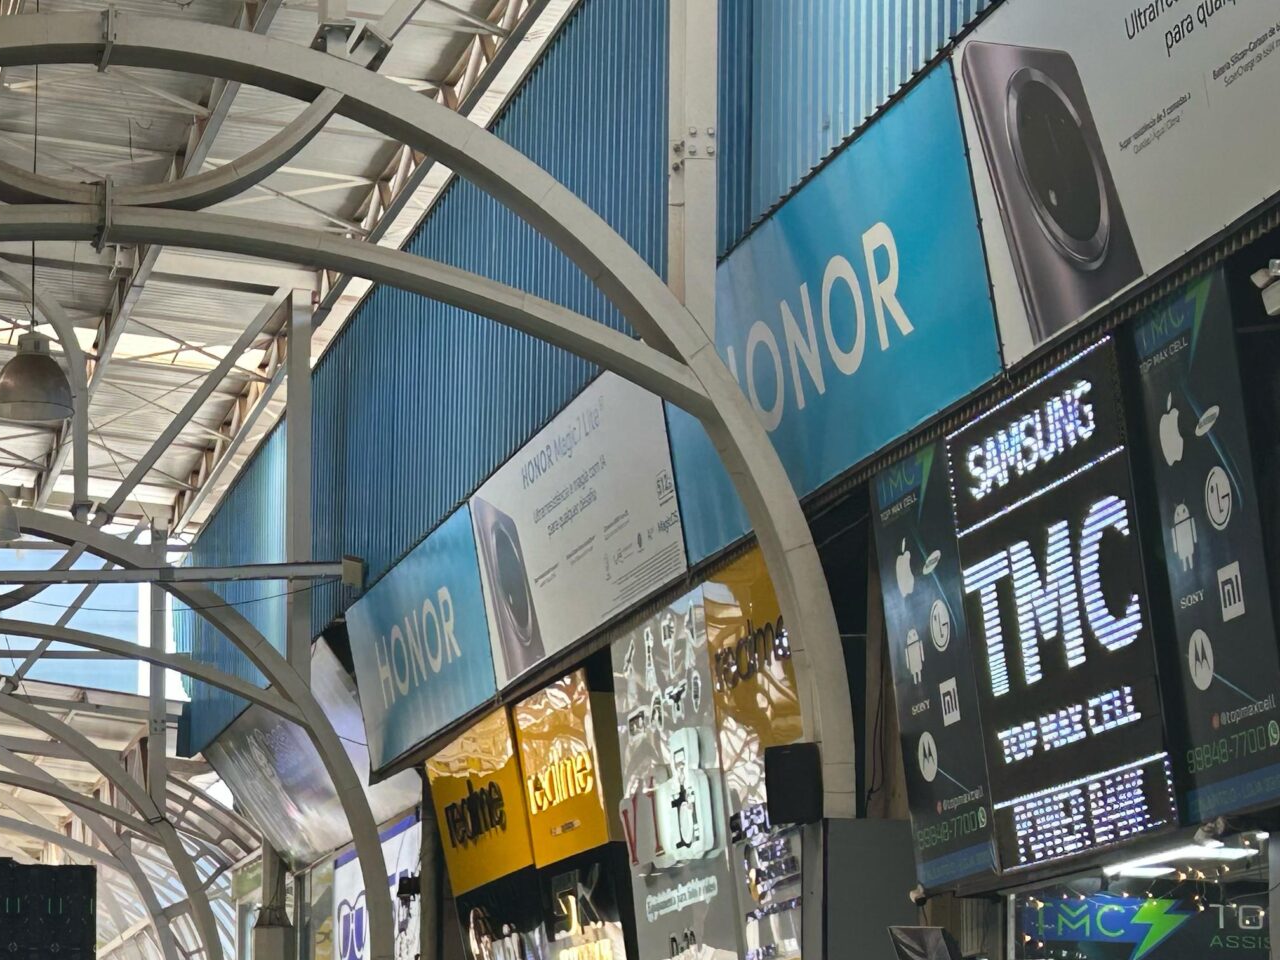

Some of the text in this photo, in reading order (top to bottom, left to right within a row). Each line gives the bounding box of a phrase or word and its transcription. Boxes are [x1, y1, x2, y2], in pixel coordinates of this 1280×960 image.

[1165, 14, 1194, 58] para
[725, 222, 915, 433] ONOR
[1139, 336, 1189, 375] TOP MAX CELL
[521, 443, 554, 490] HONOR
[966, 378, 1095, 500] SAMSUNG
[962, 494, 1143, 698] TMC
[1180, 588, 1205, 609] SONY
[373, 584, 462, 709] HONOR
[527, 743, 594, 815] realme
[1186, 725, 1267, 775] 99848-7700
[443, 779, 508, 849] realme
[1033, 901, 1126, 938] TMC
